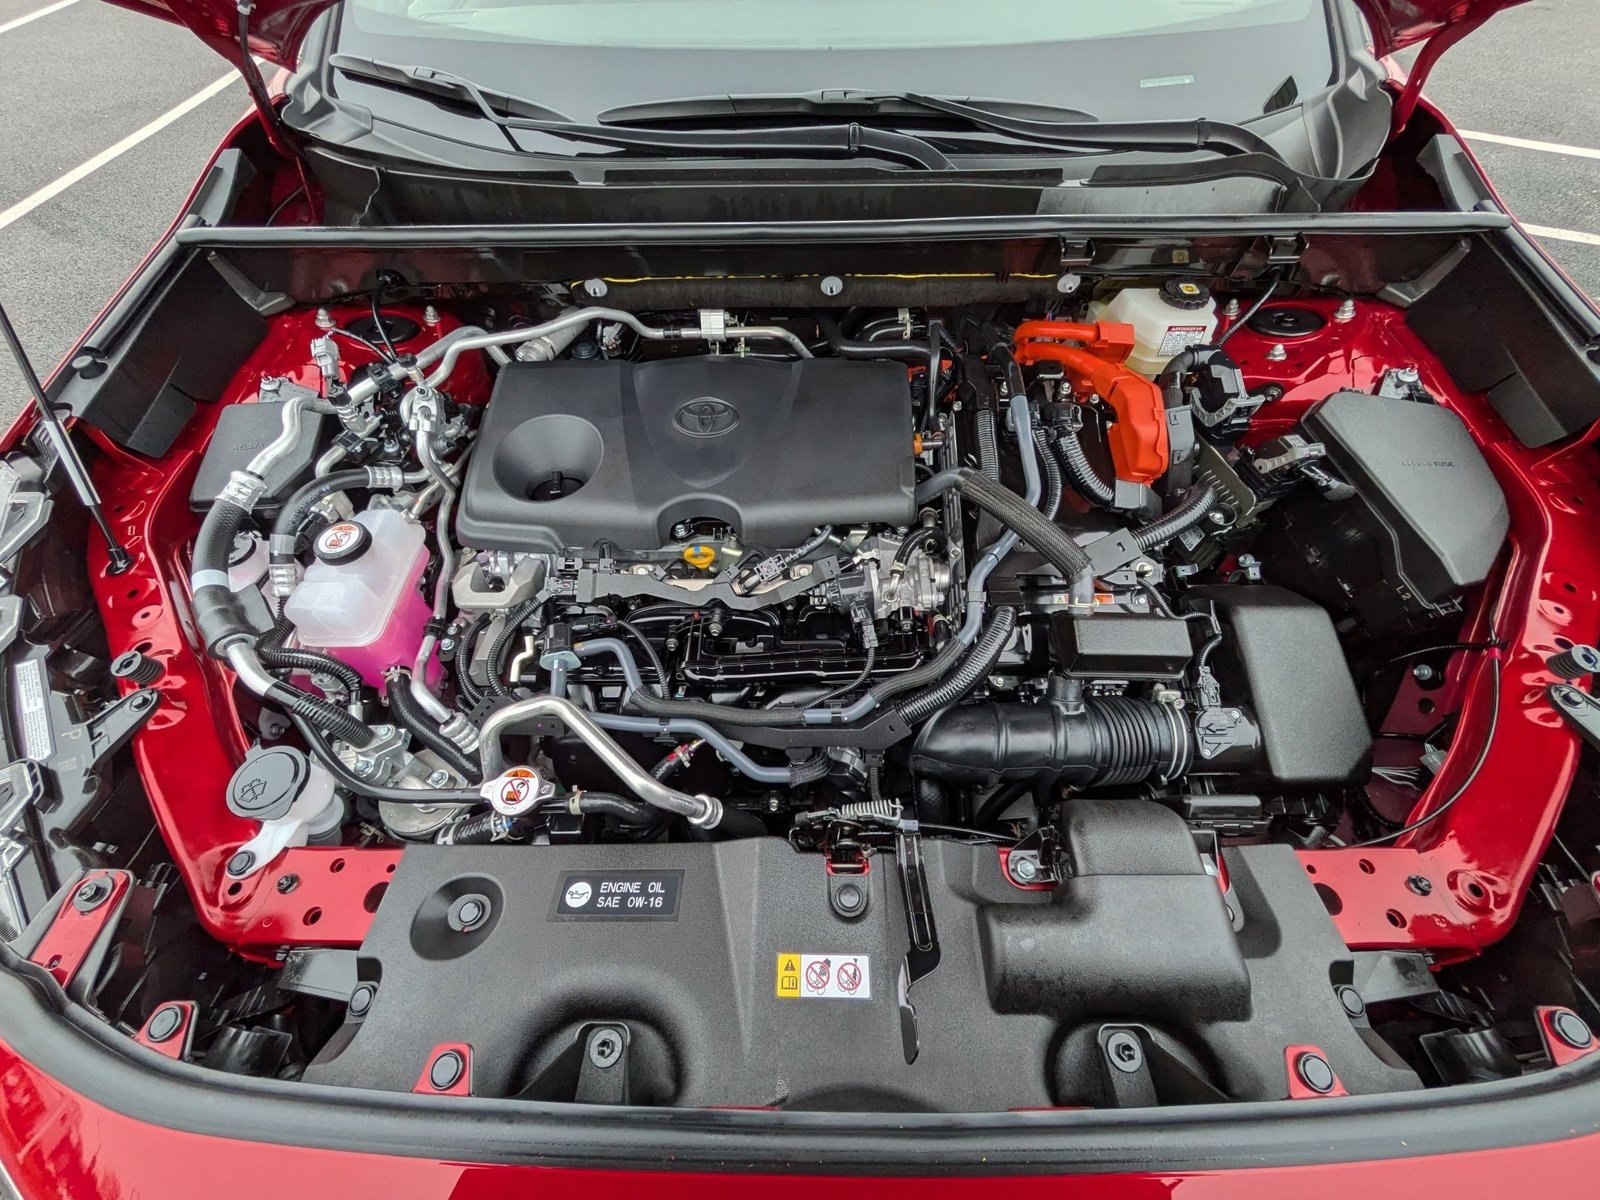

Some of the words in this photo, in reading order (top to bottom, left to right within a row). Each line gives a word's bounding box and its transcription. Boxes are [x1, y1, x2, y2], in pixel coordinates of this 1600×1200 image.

[600, 882, 641, 893] ENGINE
[647, 882, 665, 893] OIL
[597, 896, 621, 908] SAE
[627, 896, 663, 908] 0W-16
